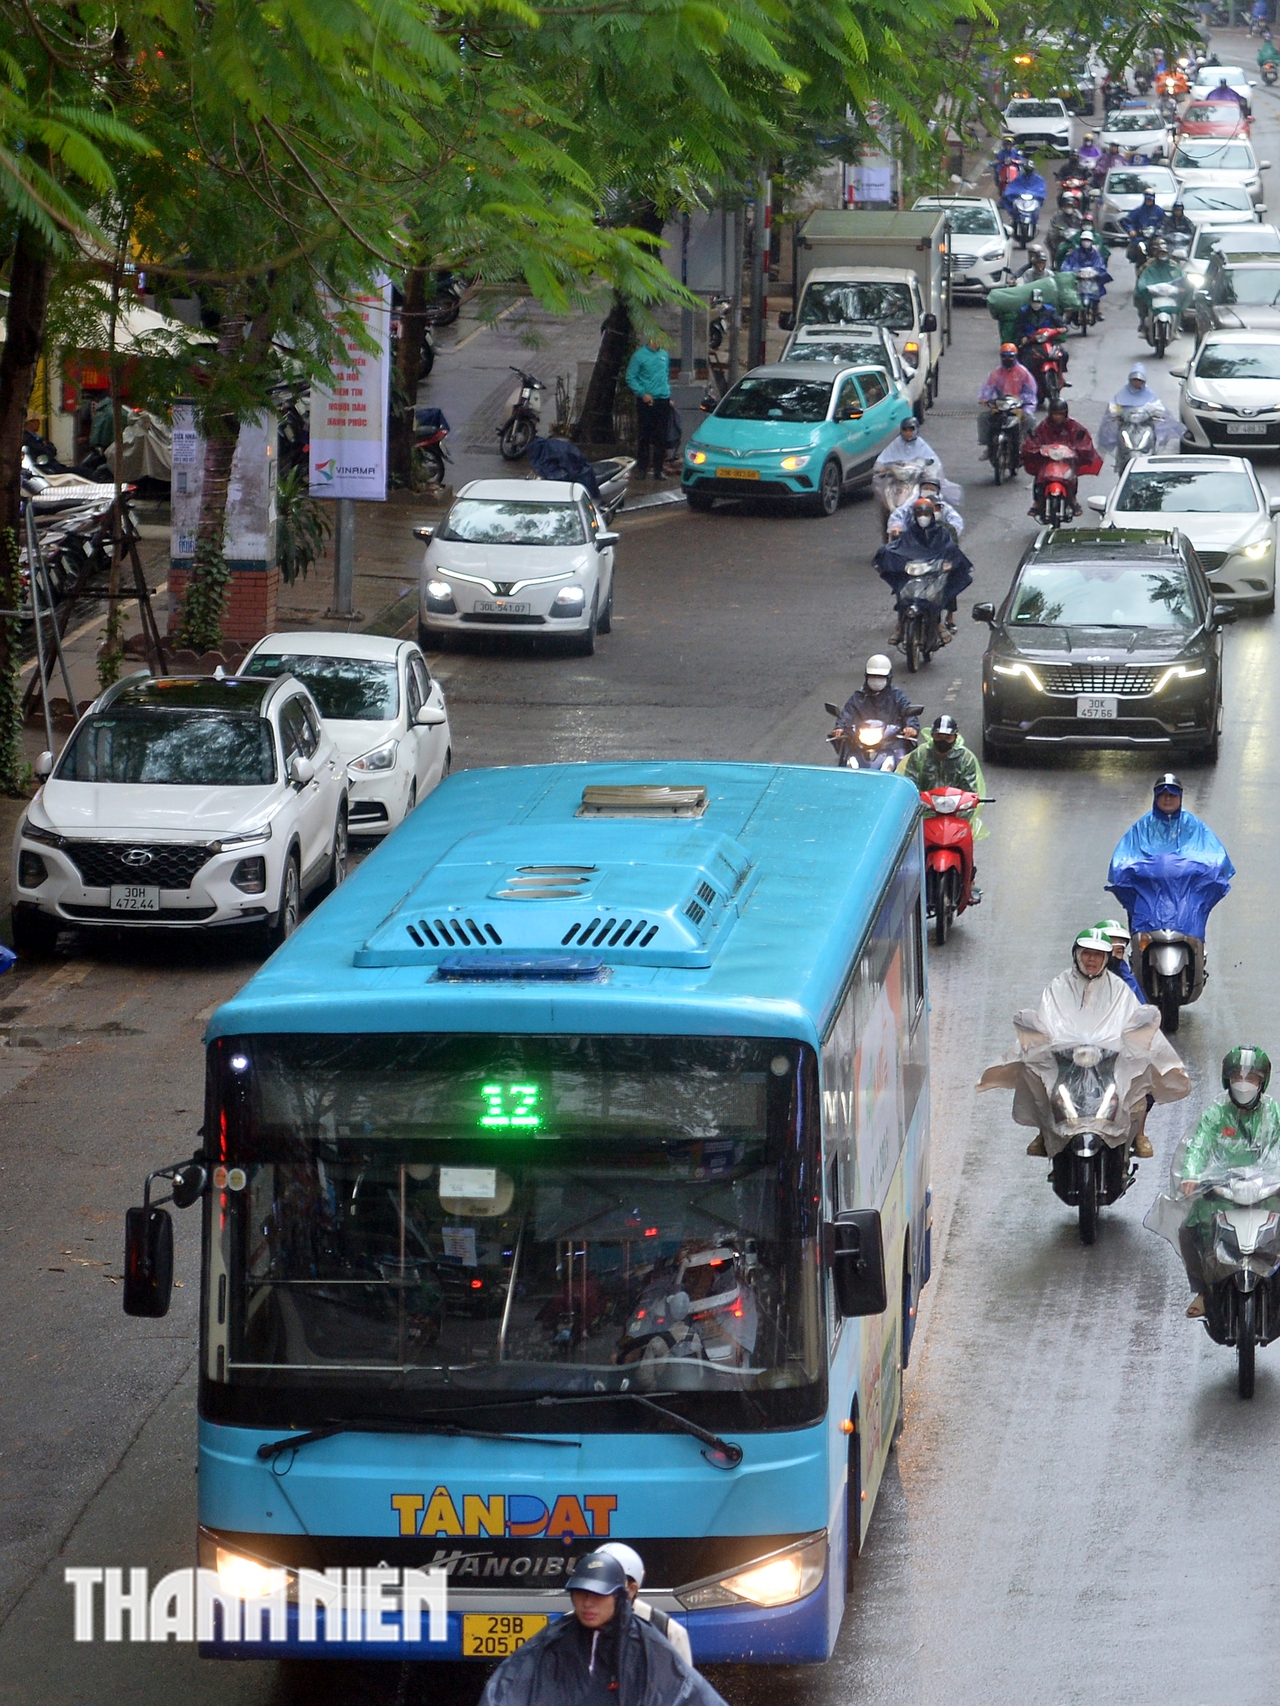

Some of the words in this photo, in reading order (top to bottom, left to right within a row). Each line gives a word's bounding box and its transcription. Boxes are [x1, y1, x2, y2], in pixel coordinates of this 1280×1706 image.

[1088, 699, 1106, 709] 30K
[1081, 709, 1113, 718] 457.66
[125, 887, 146, 898] 30H
[116, 898, 154, 909] 472.44
[488, 1617, 523, 1634] 29B
[472, 1636, 526, 1654] 205.0
